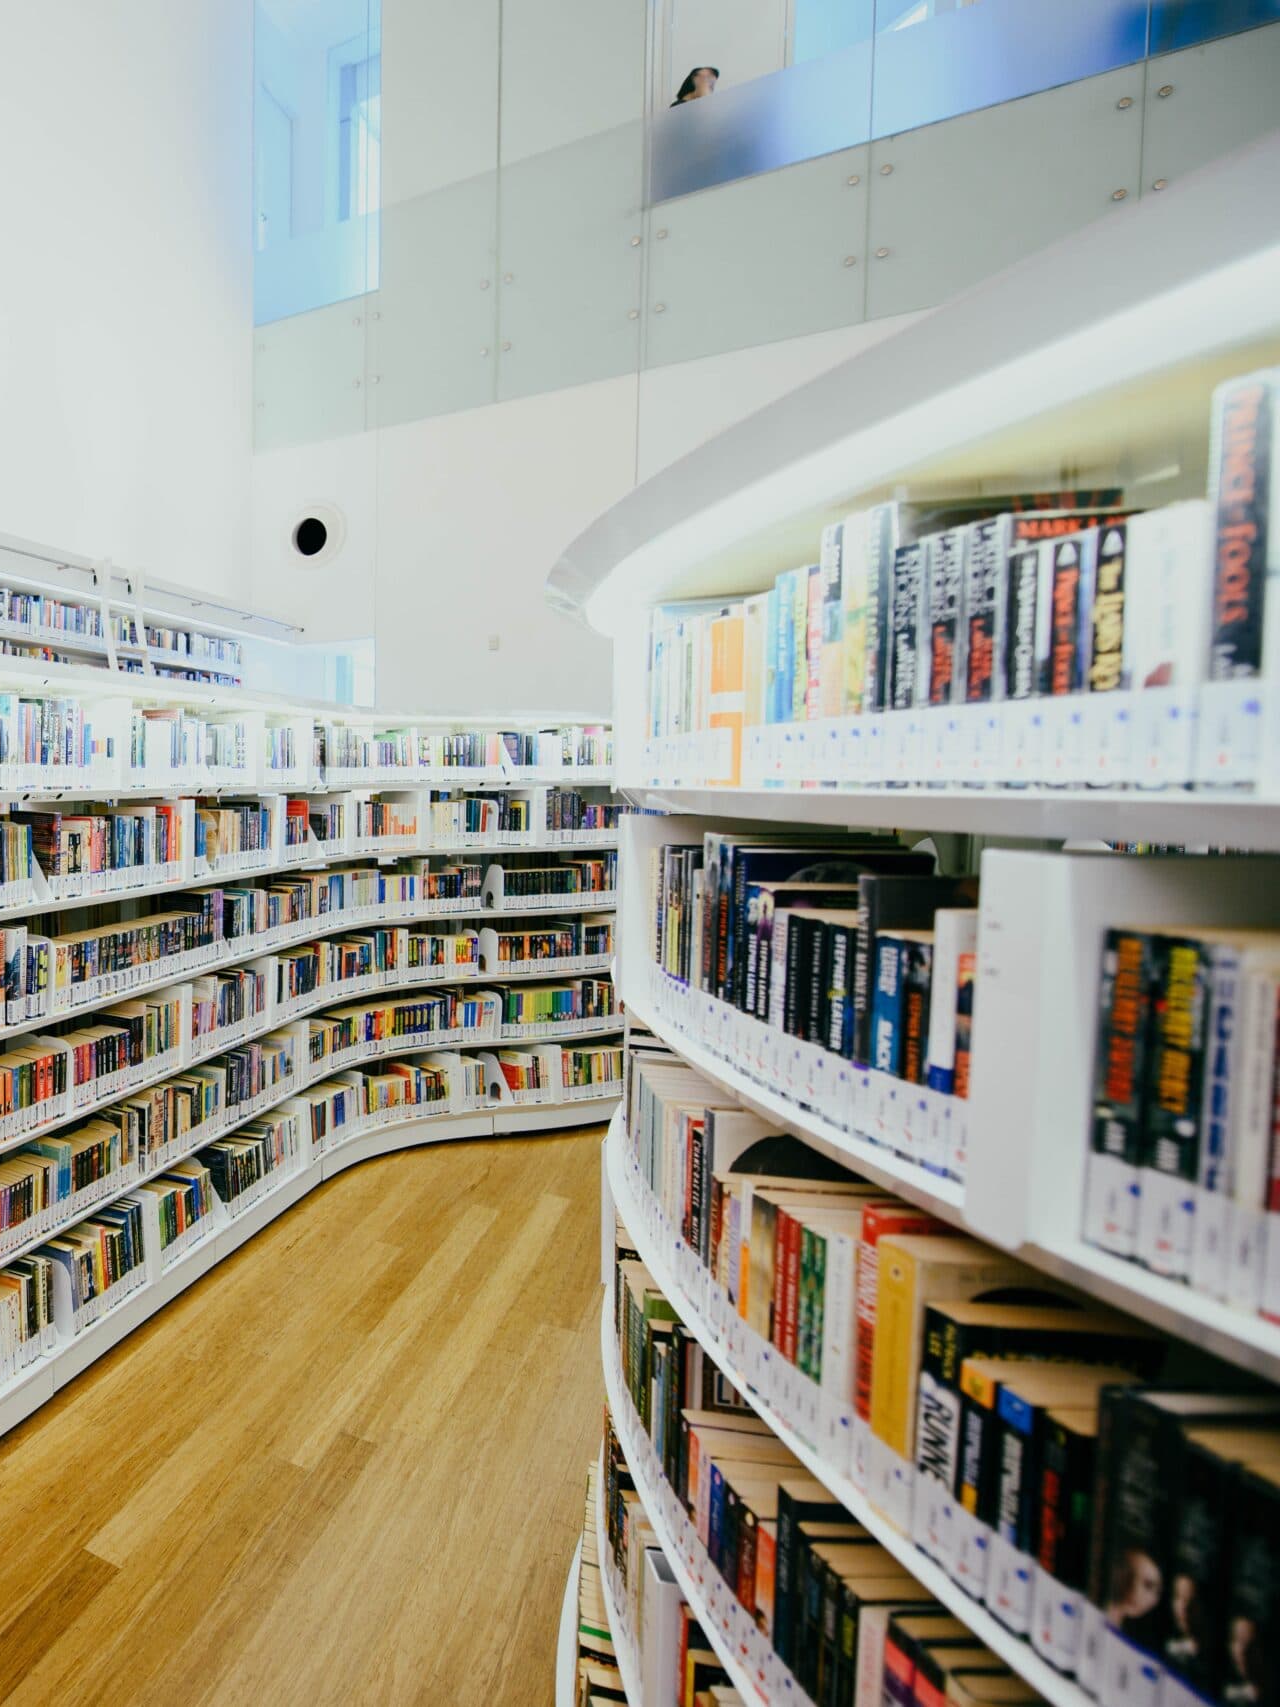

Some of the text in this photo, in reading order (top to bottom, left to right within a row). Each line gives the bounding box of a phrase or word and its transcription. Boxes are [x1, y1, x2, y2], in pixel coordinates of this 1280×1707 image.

[1017, 517, 1081, 540] MARK
[746, 934, 759, 1011] STEPHEN LEATHER
[757, 940, 769, 1017] STEPHEN LEATHER
[829, 933, 848, 1051] STEPHEN LEATHER
[906, 992, 923, 1038] STEPHEN
[928, 1331, 942, 1357] LEE
[919, 1391, 957, 1480] RUNNE
